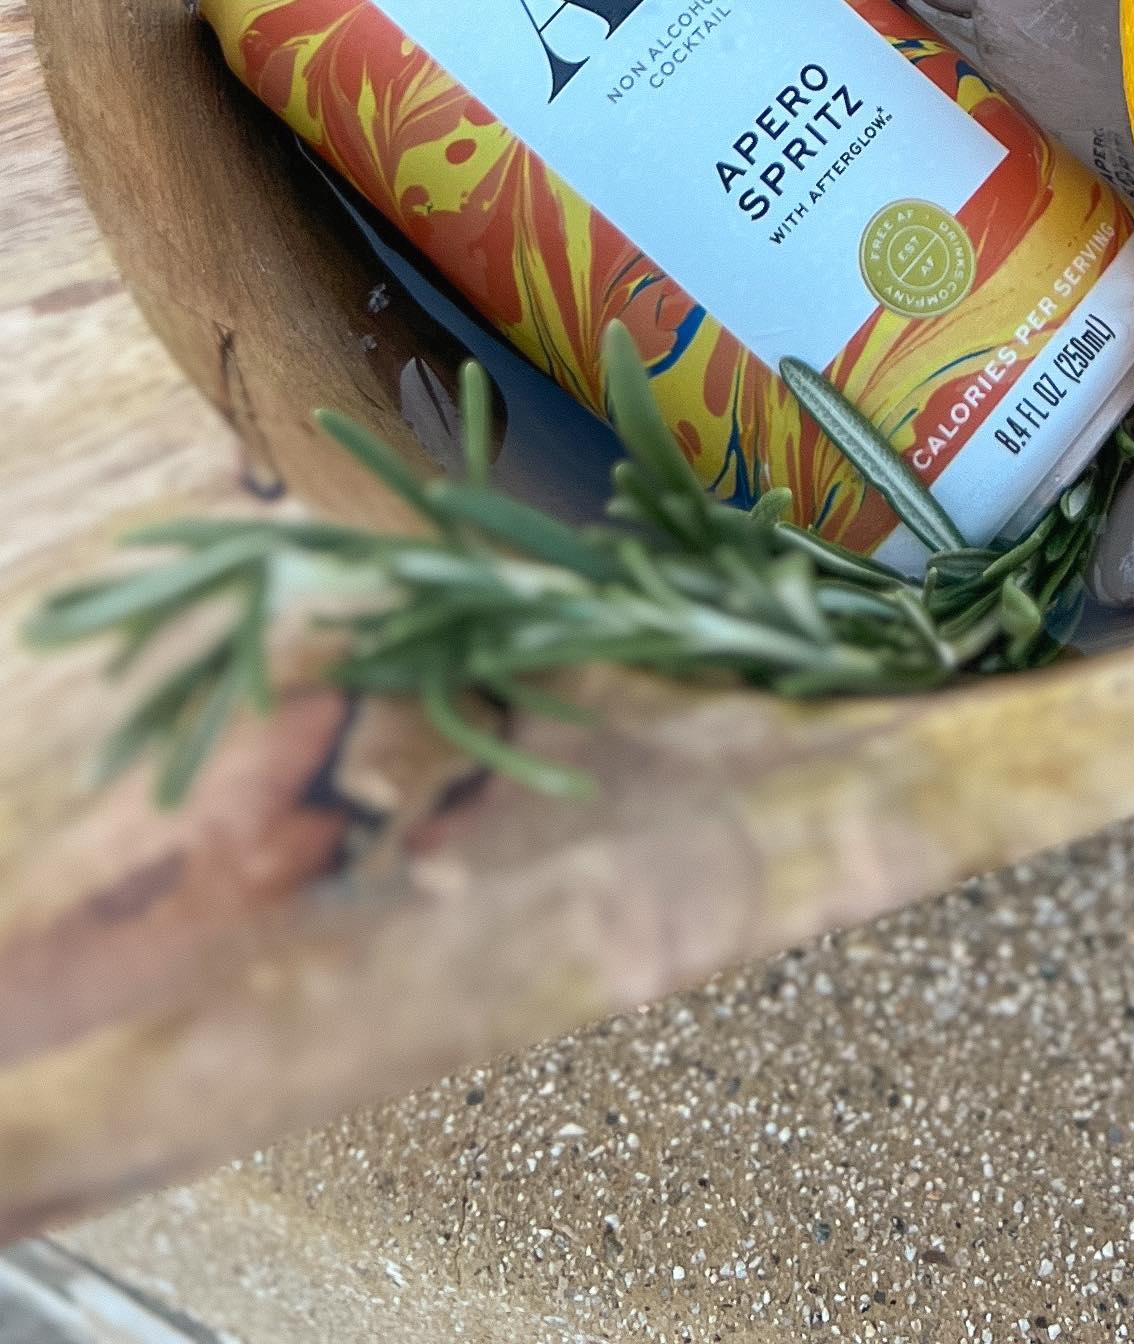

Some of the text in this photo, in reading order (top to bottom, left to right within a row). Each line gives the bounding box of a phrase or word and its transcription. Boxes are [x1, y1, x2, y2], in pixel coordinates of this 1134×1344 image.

[606, 59, 649, 105] NON
[648, 5, 732, 89] COCKTAIL
[715, 63, 829, 194] APERO
[738, 84, 864, 222] SPRITZ
[769, 202, 810, 246] WITH
[912, 220, 1115, 470] CALORIES PER SERVING
[994, 312, 1116, 456] 8.4 FL OZ (250mL)
